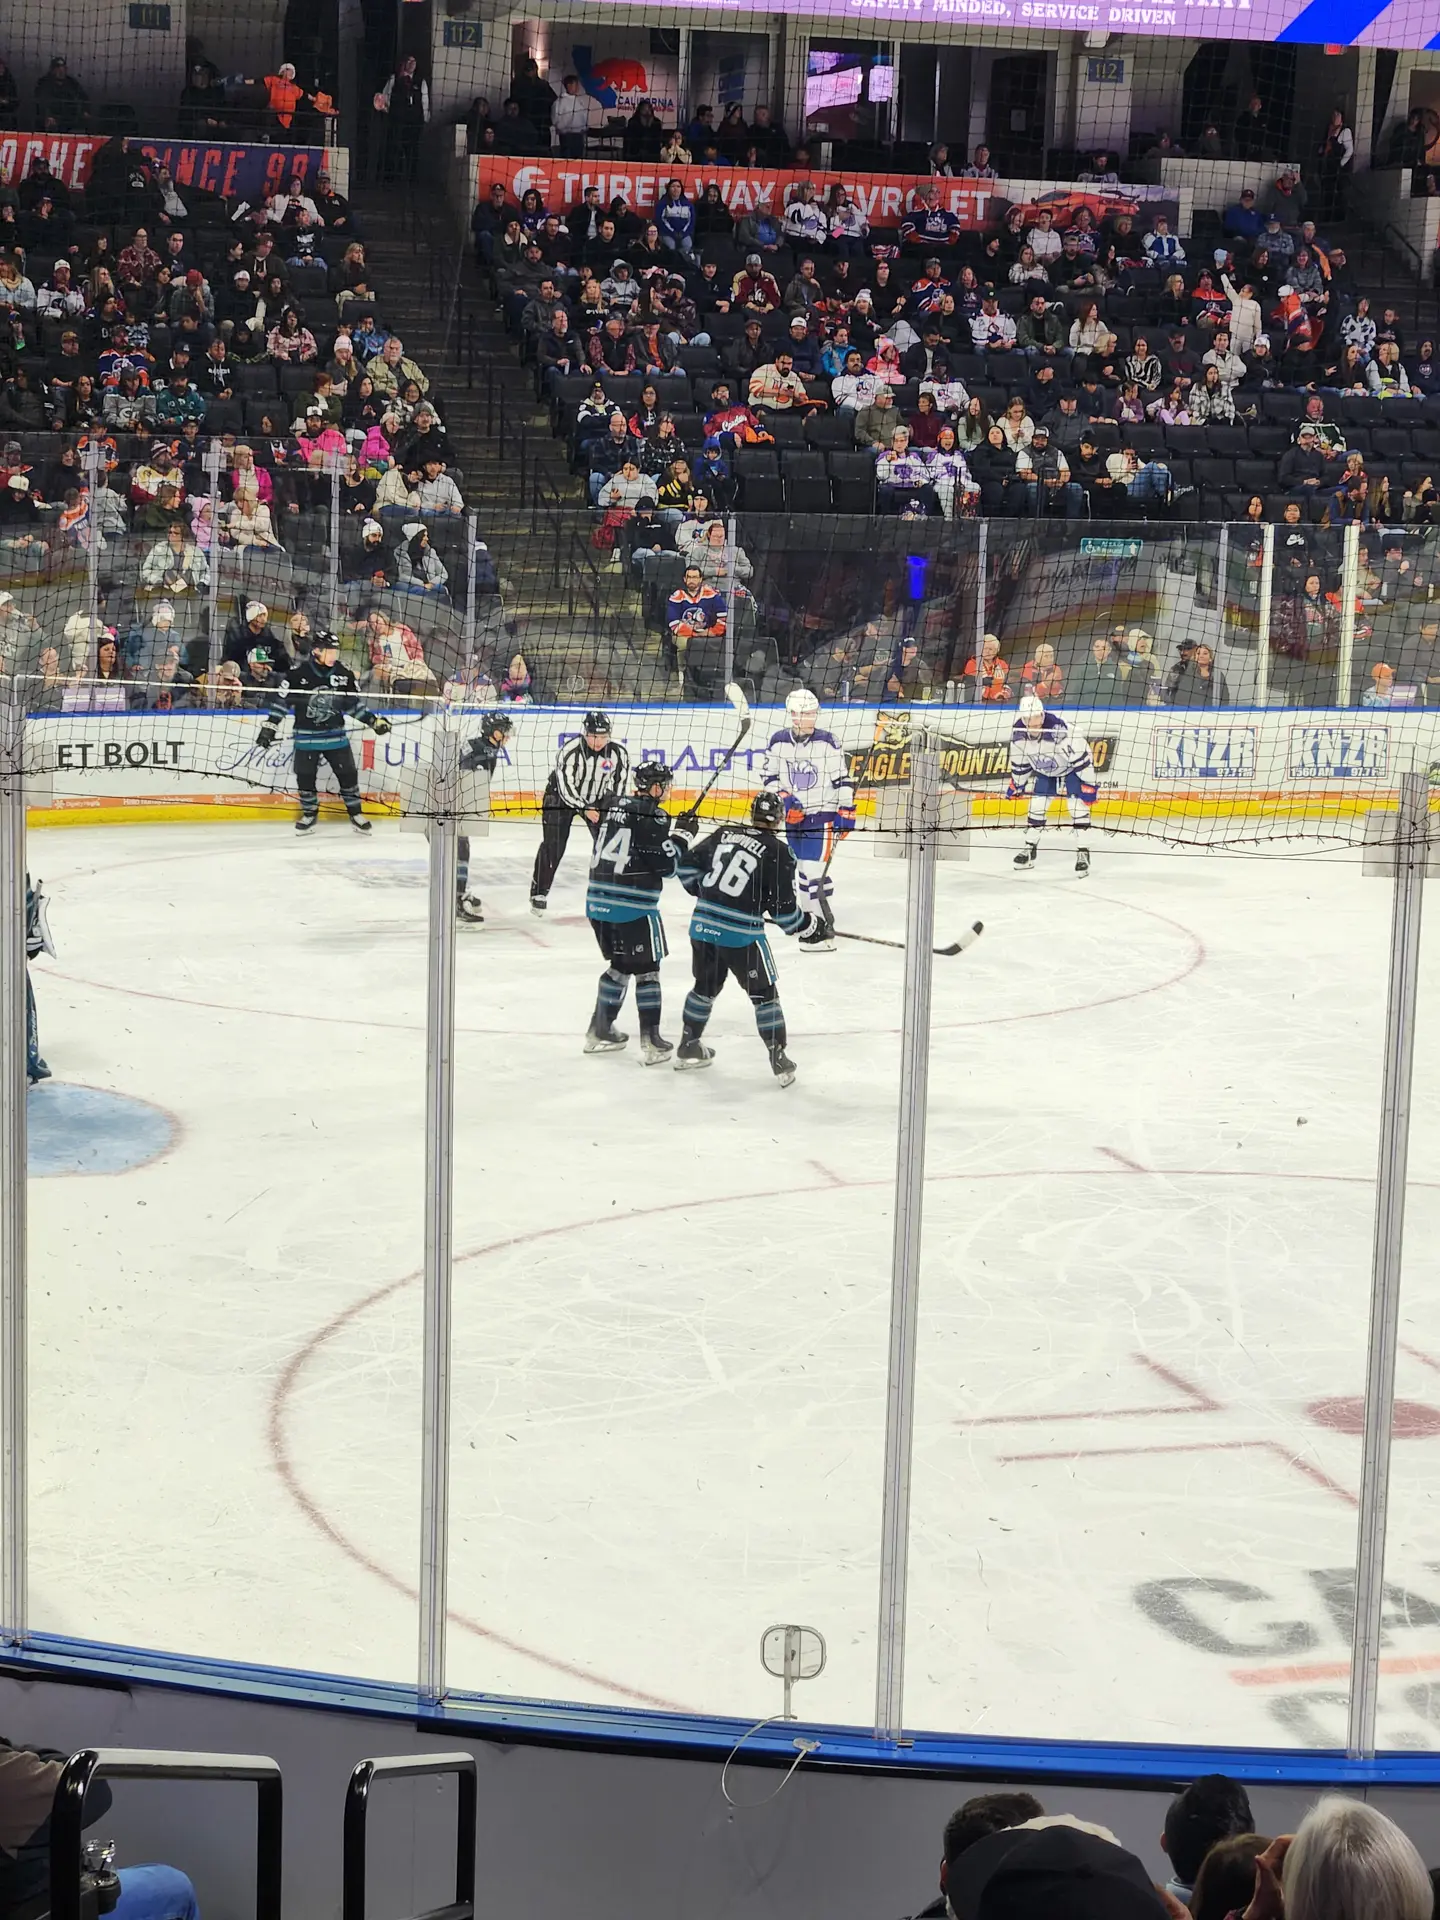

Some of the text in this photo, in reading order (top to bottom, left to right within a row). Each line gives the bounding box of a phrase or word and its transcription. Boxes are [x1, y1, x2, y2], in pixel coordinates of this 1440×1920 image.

[1021, 2, 1099, 20] SERVICE
[1108, 7, 1176, 25] DRIVEN
[450, 25, 476, 44] 112
[1095, 63, 1118, 81] 112
[618, 96, 674, 107] CALIRNIA
[783, 179, 992, 221] CHEVROET
[58, 741, 185, 768] ET BOLT
[1156, 729, 1255, 768] KNZR
[1291, 728, 1388, 768] KNZR
[848, 747, 1012, 782] EAGLE OUNTA
[1155, 767, 1182, 777] 1560
[1184, 767, 1200, 777] AM
[1238, 767, 1253, 777] FM
[1290, 767, 1317, 777] 1560
[1318, 767, 1335, 777] AM
[1350, 767, 1371, 777] 97.7
[702, 844, 758, 897] 56
